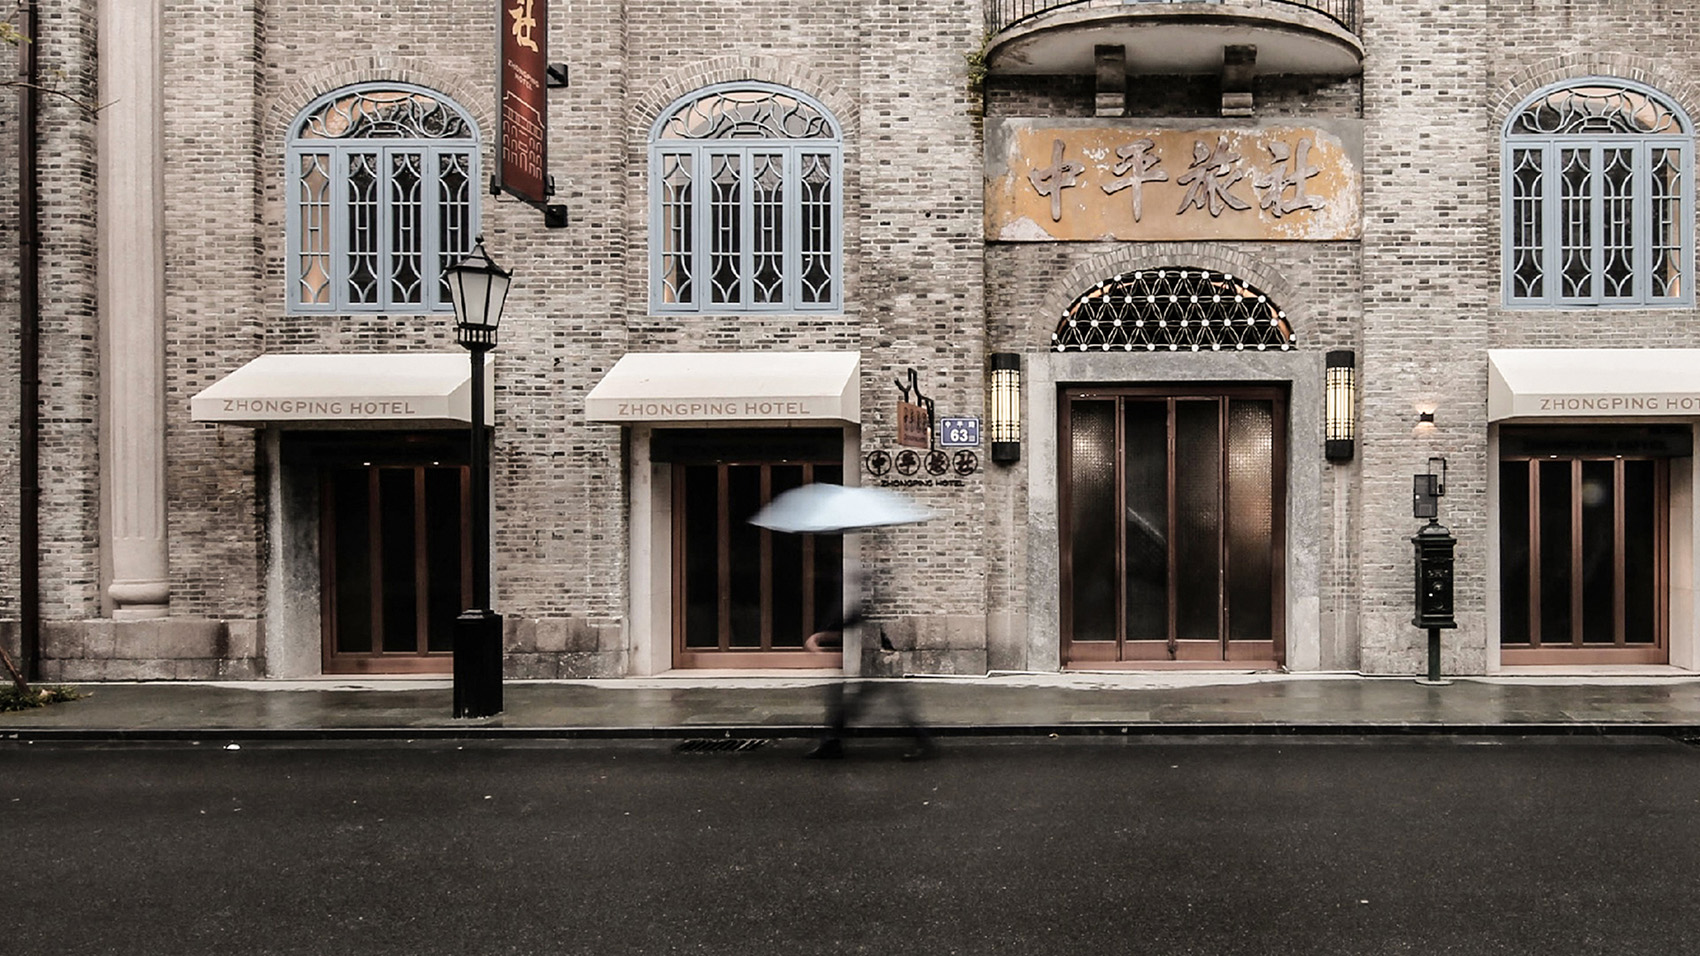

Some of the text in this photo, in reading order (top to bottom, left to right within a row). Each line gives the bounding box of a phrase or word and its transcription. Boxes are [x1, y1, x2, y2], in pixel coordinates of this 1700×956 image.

[1028, 136, 1327, 222] 中平旅社
[224, 400, 415, 414] ZHONGPING HOTEL
[619, 402, 810, 415] ZHONGPING HOTEL
[1540, 398, 1658, 410] ZHONGPING
[950, 429, 968, 442] 63
